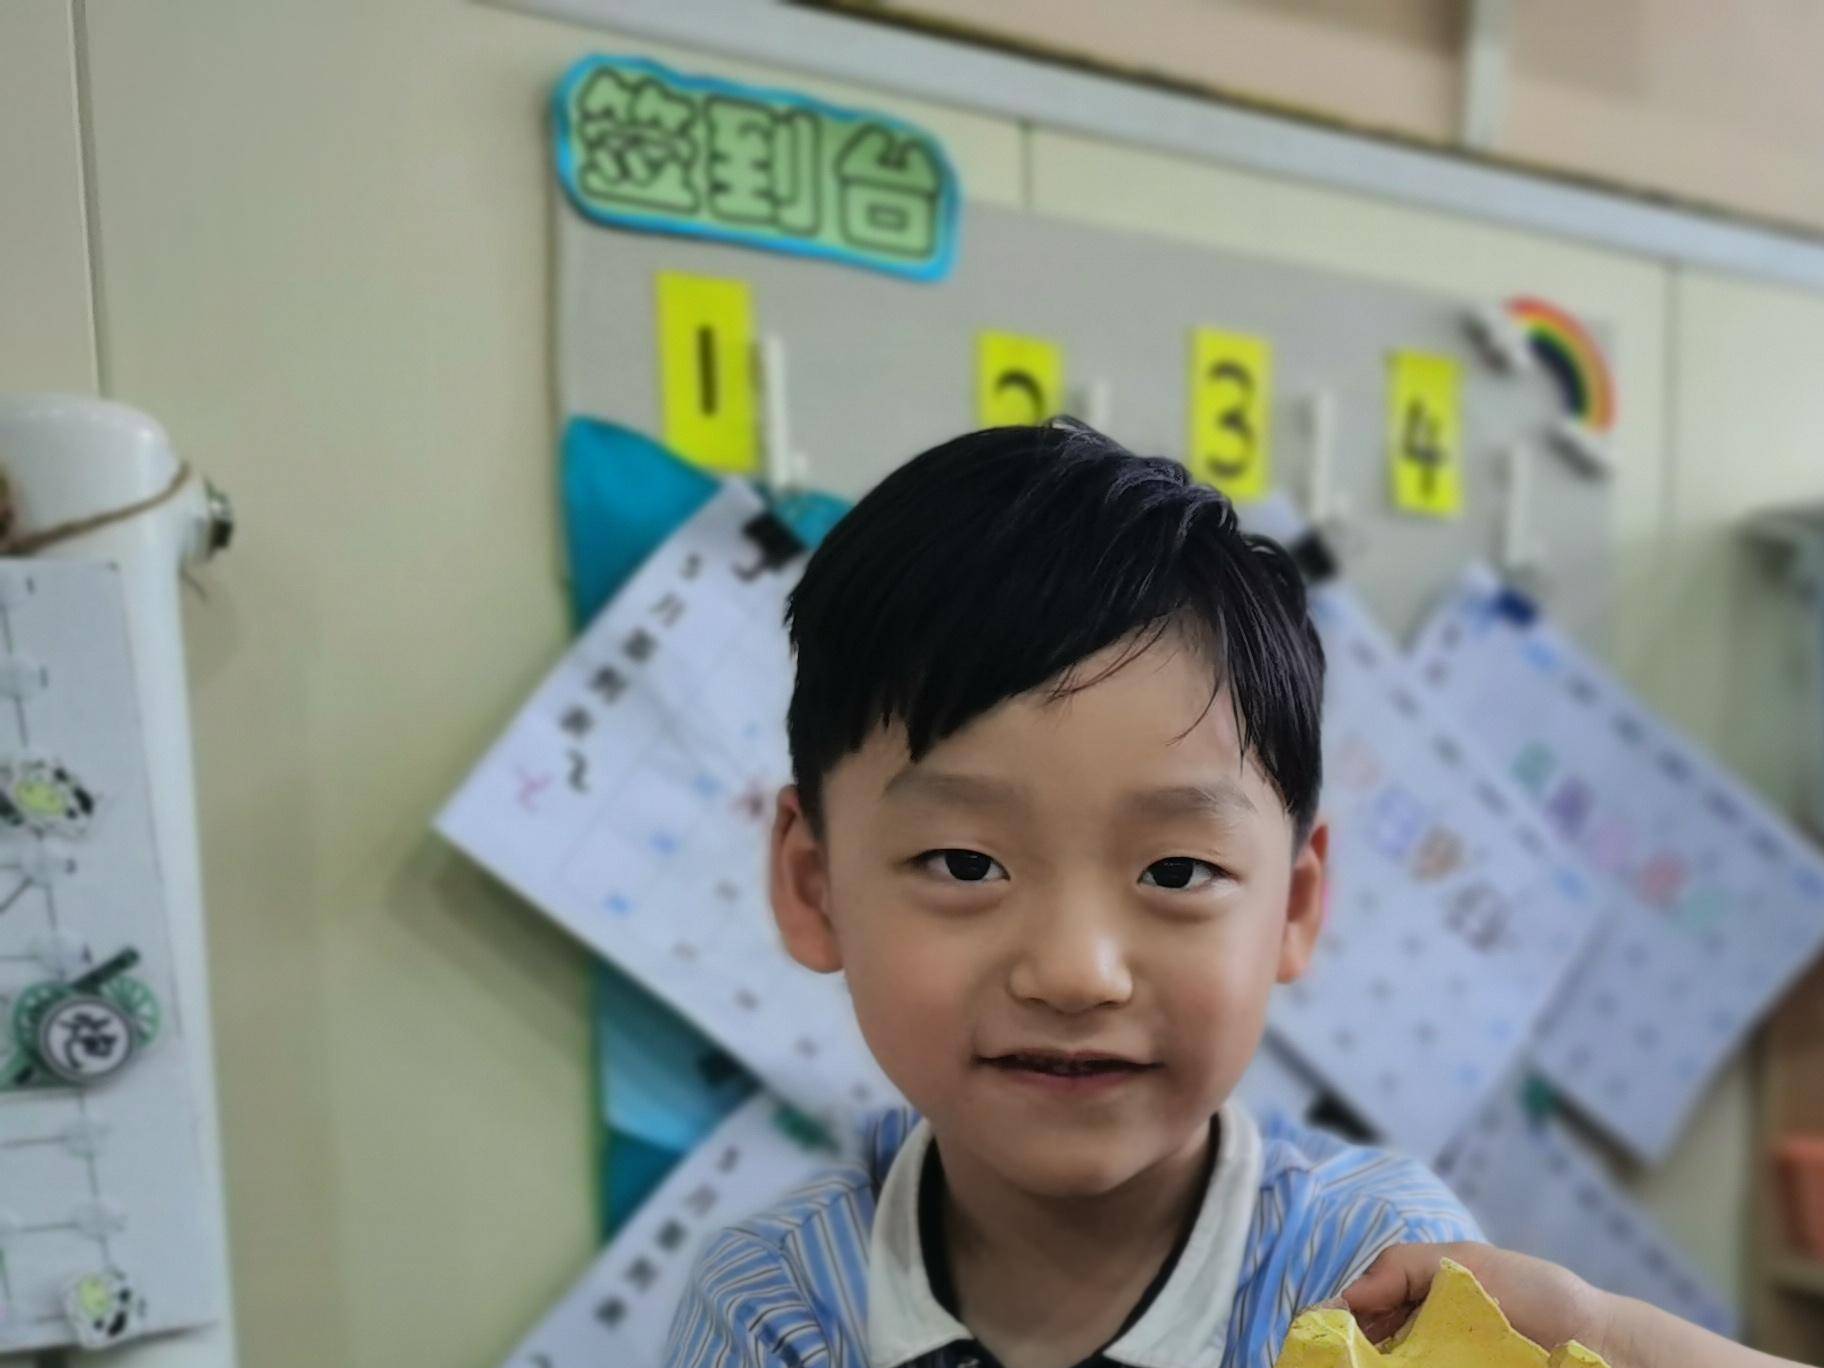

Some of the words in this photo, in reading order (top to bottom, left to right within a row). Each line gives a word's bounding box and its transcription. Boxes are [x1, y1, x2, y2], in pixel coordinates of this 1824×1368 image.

[577, 66, 944, 259] 签到台
[695, 325, 718, 417] 1
[1206, 358, 1257, 478] 3
[1401, 396, 1449, 499] 4
